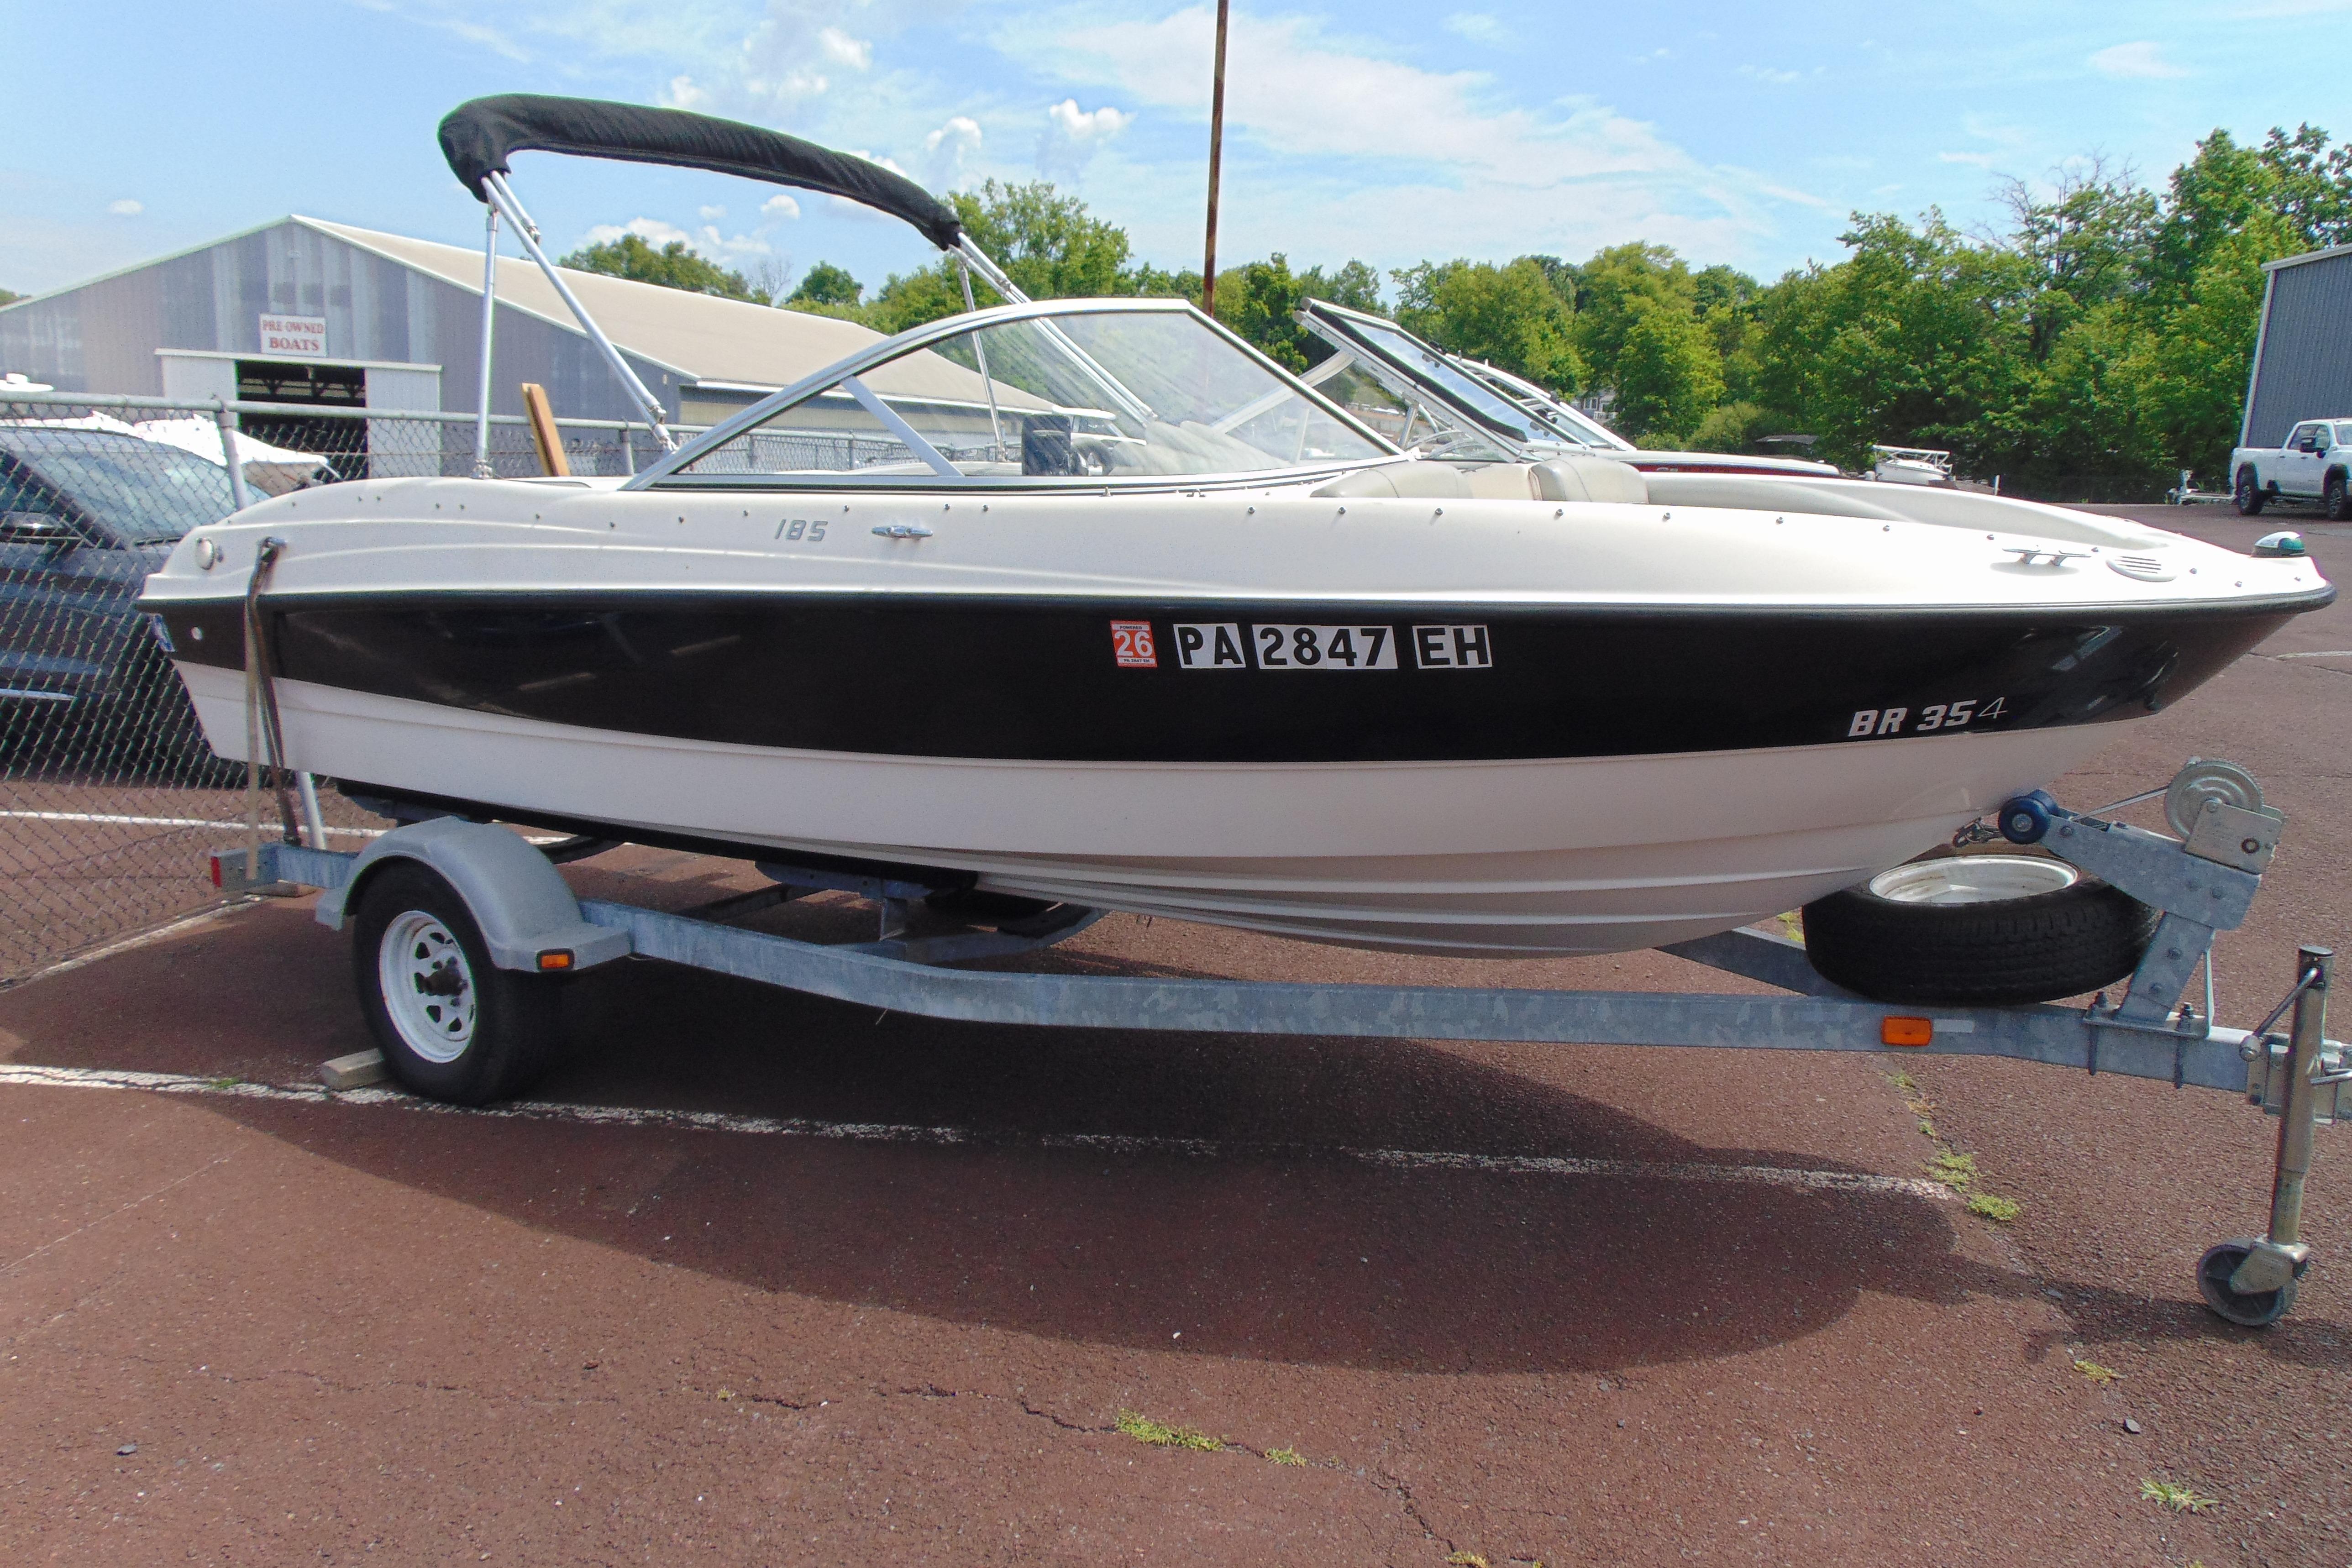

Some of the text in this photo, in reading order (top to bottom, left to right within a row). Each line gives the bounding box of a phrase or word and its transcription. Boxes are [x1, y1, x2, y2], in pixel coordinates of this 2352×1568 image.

[268, 337, 319, 351] BOATS
[775, 519, 828, 541] 185
[1115, 631, 1153, 657] 26
[1178, 626, 1489, 666] PA 2847 EH
[1848, 707, 1907, 737] BR
